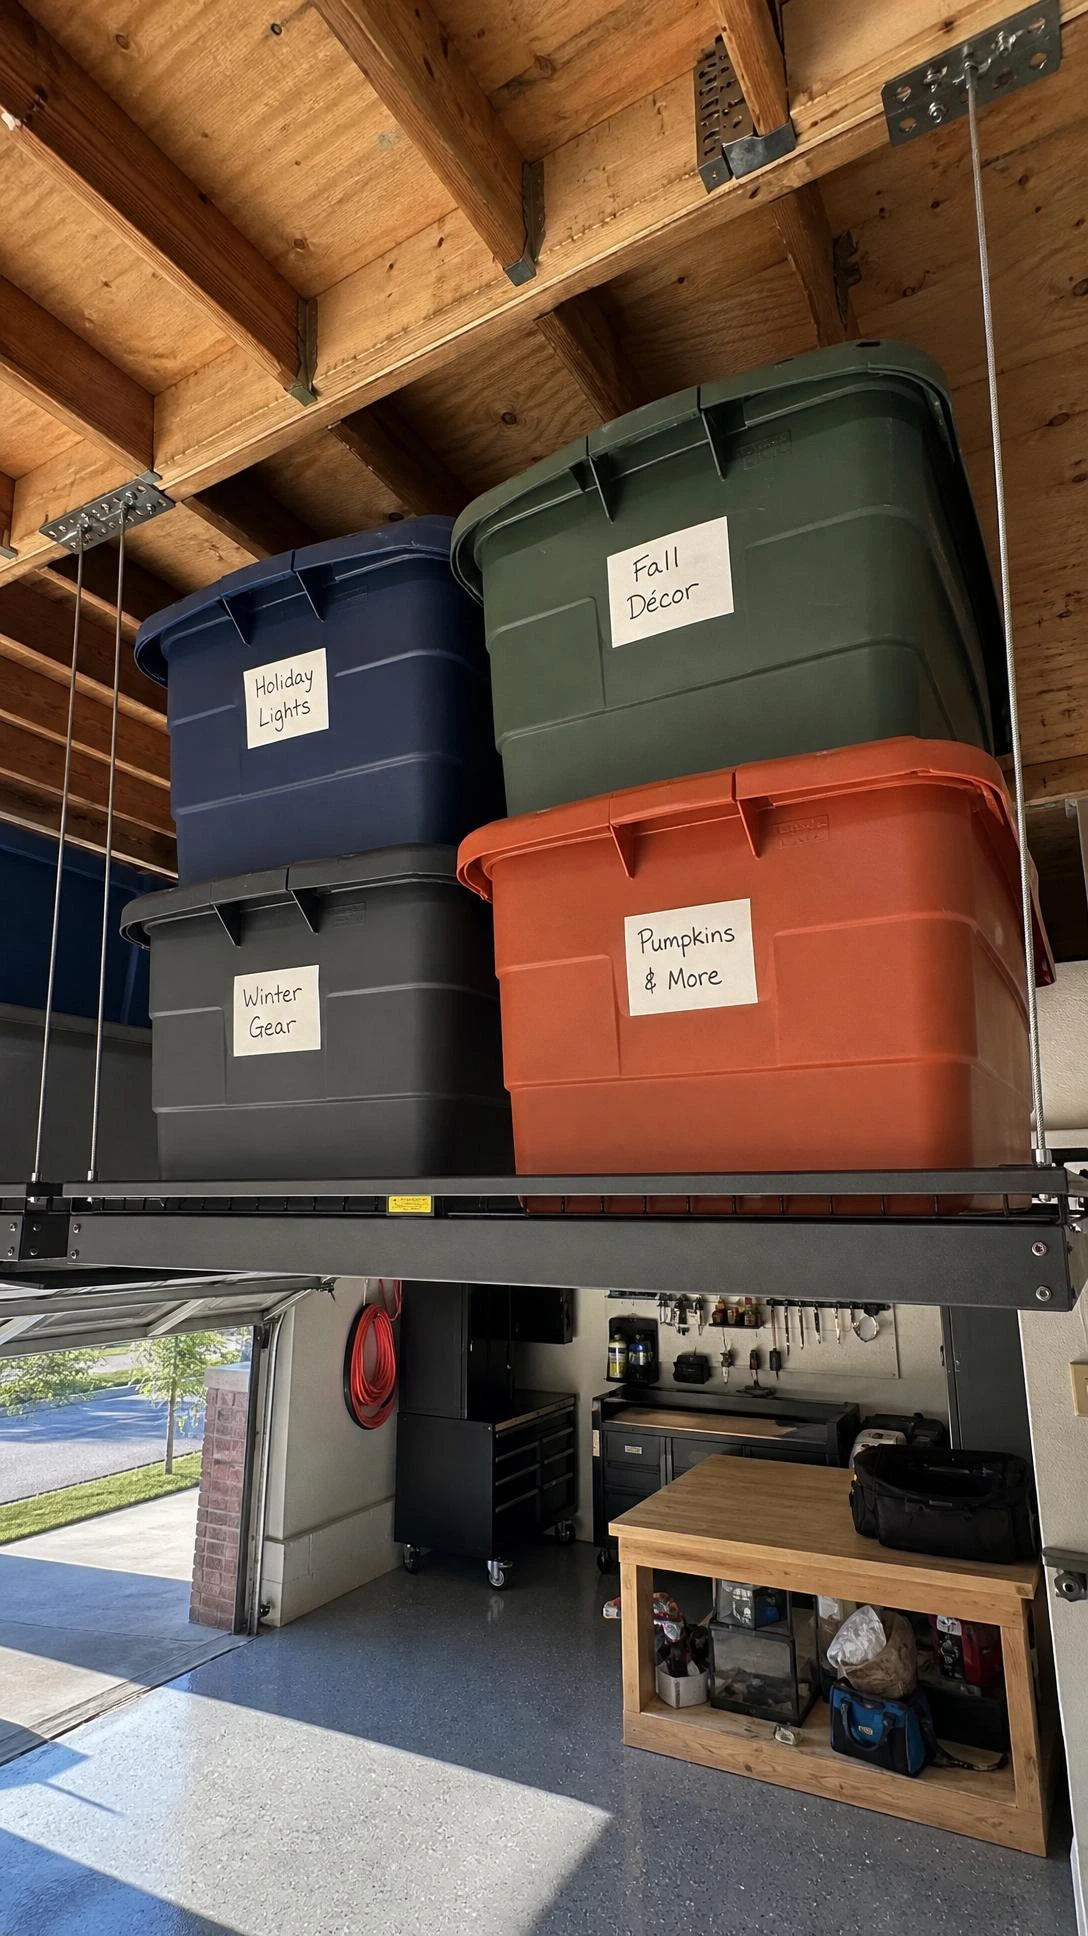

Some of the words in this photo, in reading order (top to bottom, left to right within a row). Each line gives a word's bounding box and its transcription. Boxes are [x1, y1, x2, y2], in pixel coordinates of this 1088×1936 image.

[632, 546, 679, 582] Fall
[626, 583, 700, 620] Décor
[255, 668, 313, 698] Holiday
[259, 698, 311, 732] Lights
[637, 926, 735, 958] Pumpkins
[243, 984, 302, 1007] Winter
[644, 967, 657, 994] &
[668, 967, 723, 990] More
[249, 1015, 297, 1038] Gear
